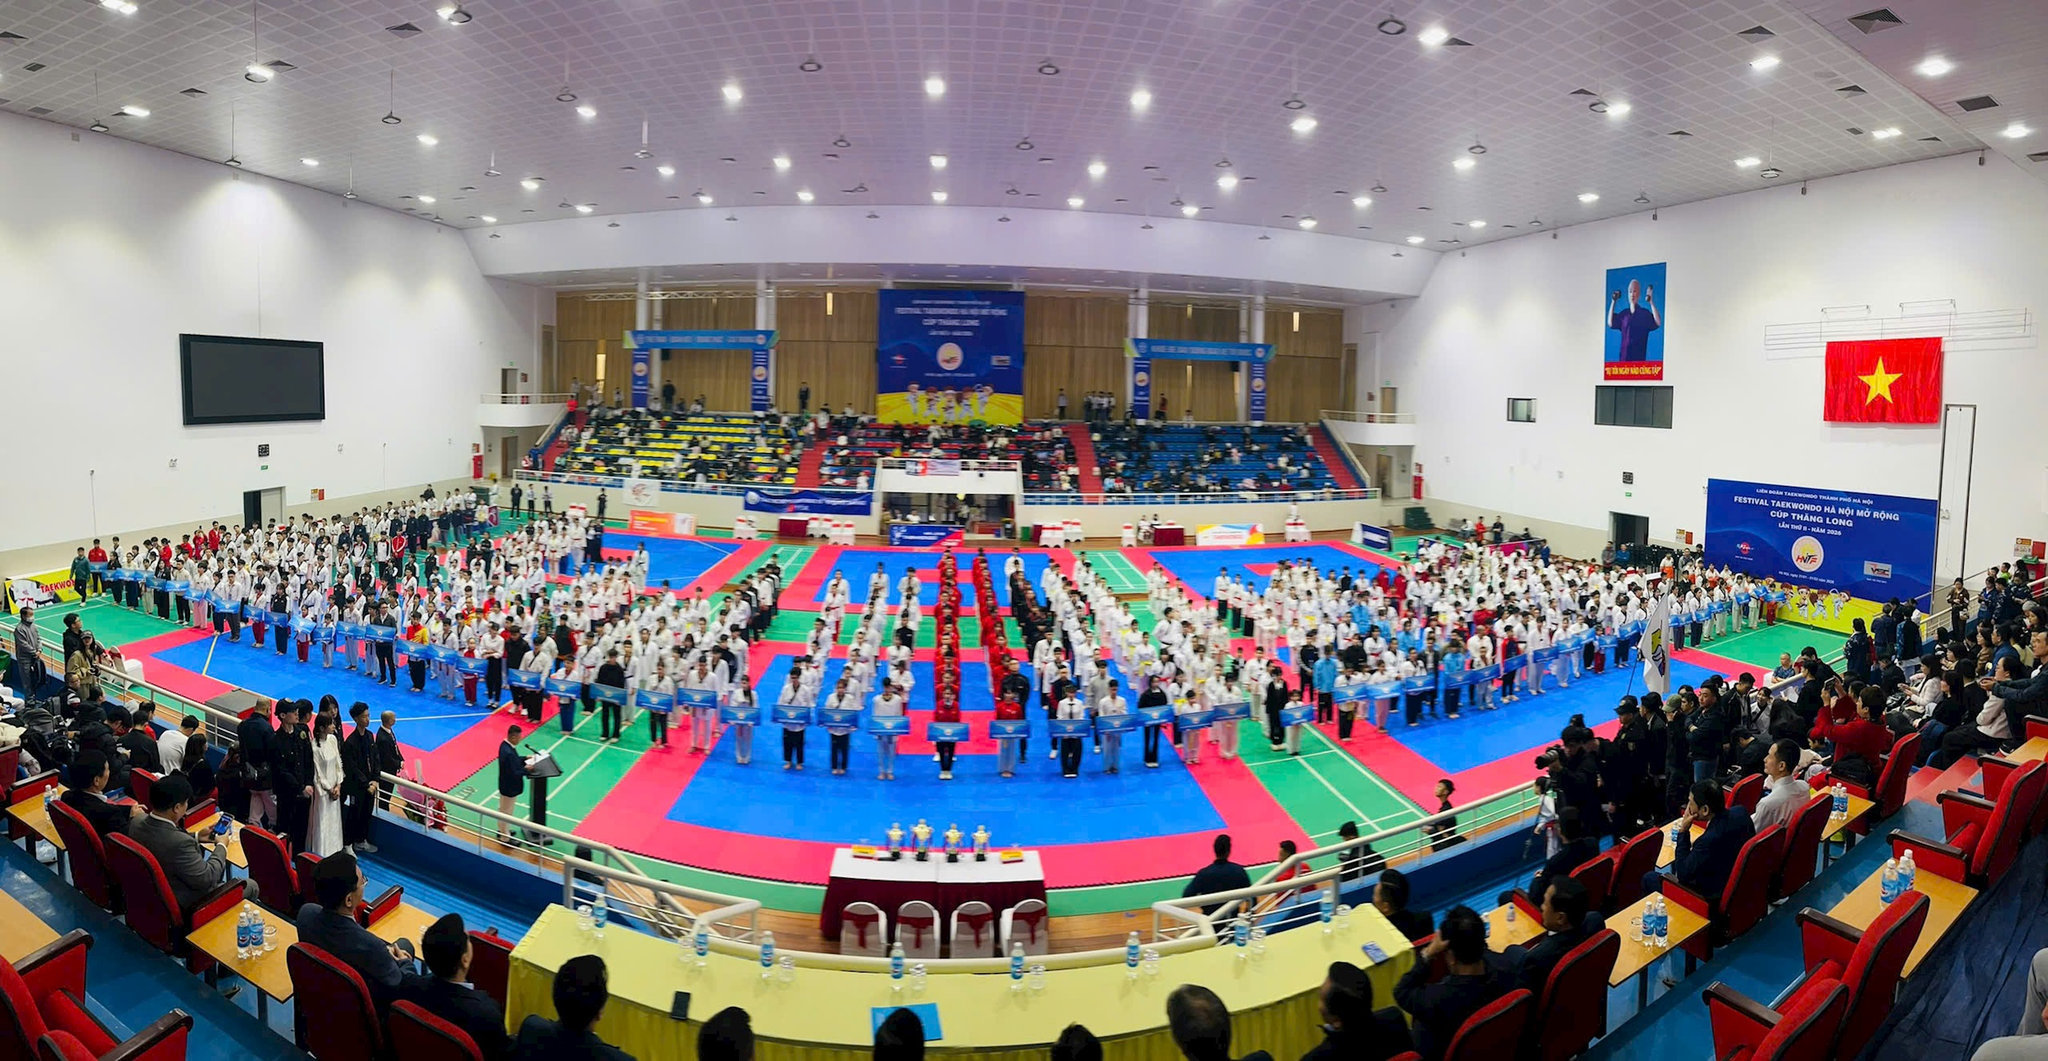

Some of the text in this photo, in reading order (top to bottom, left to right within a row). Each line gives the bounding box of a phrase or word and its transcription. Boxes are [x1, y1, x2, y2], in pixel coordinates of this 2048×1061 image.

[1784, 491, 1818, 499] TAEKWONDO
[1734, 495, 1900, 521] FESTIVAL TAEKWONDO HÀ NỘI MỞ RỘNG
[1770, 510, 1853, 527] CÚP THĂNG LONG
[40, 579, 75, 593] TAEKWON
